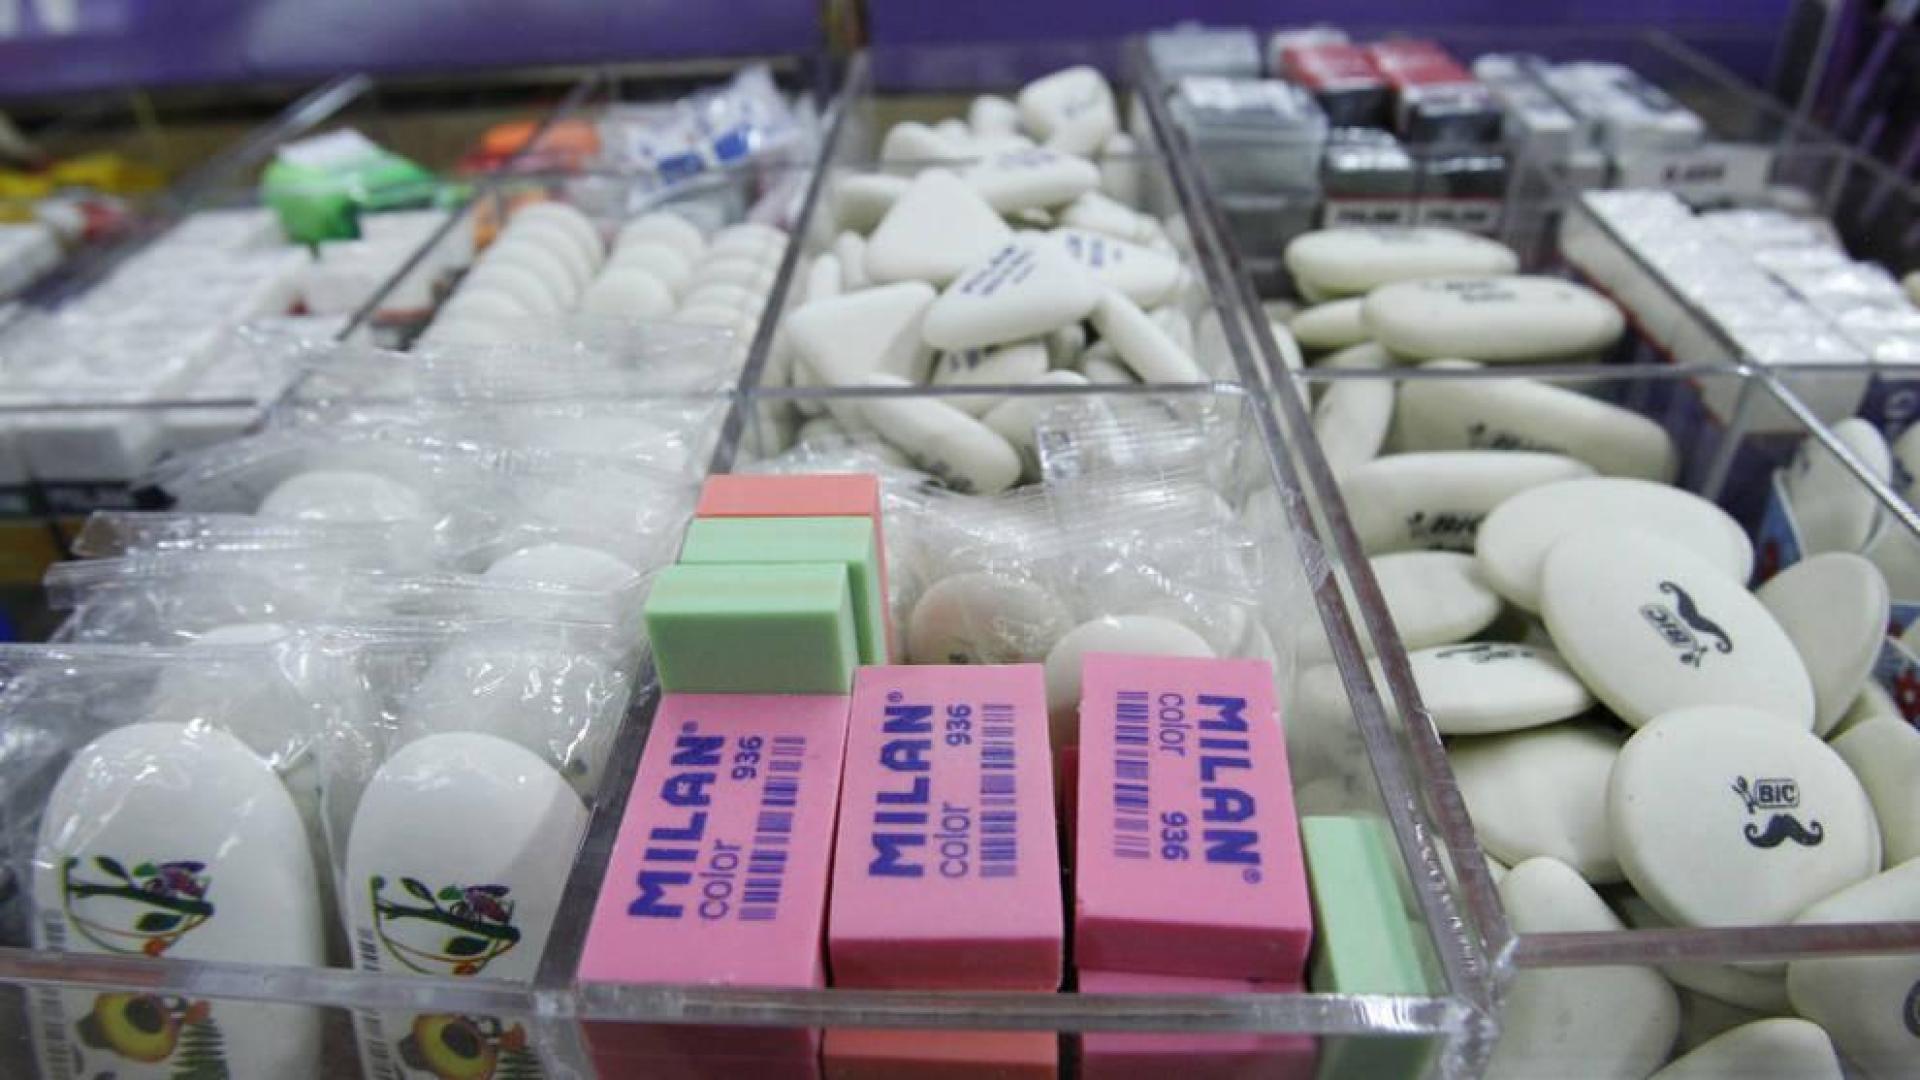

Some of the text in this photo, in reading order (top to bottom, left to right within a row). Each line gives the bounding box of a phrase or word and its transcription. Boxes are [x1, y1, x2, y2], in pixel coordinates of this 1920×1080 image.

[698, 736, 763, 919] color 936
[933, 704, 972, 878] color 936
[1158, 693, 1193, 860] color 936
